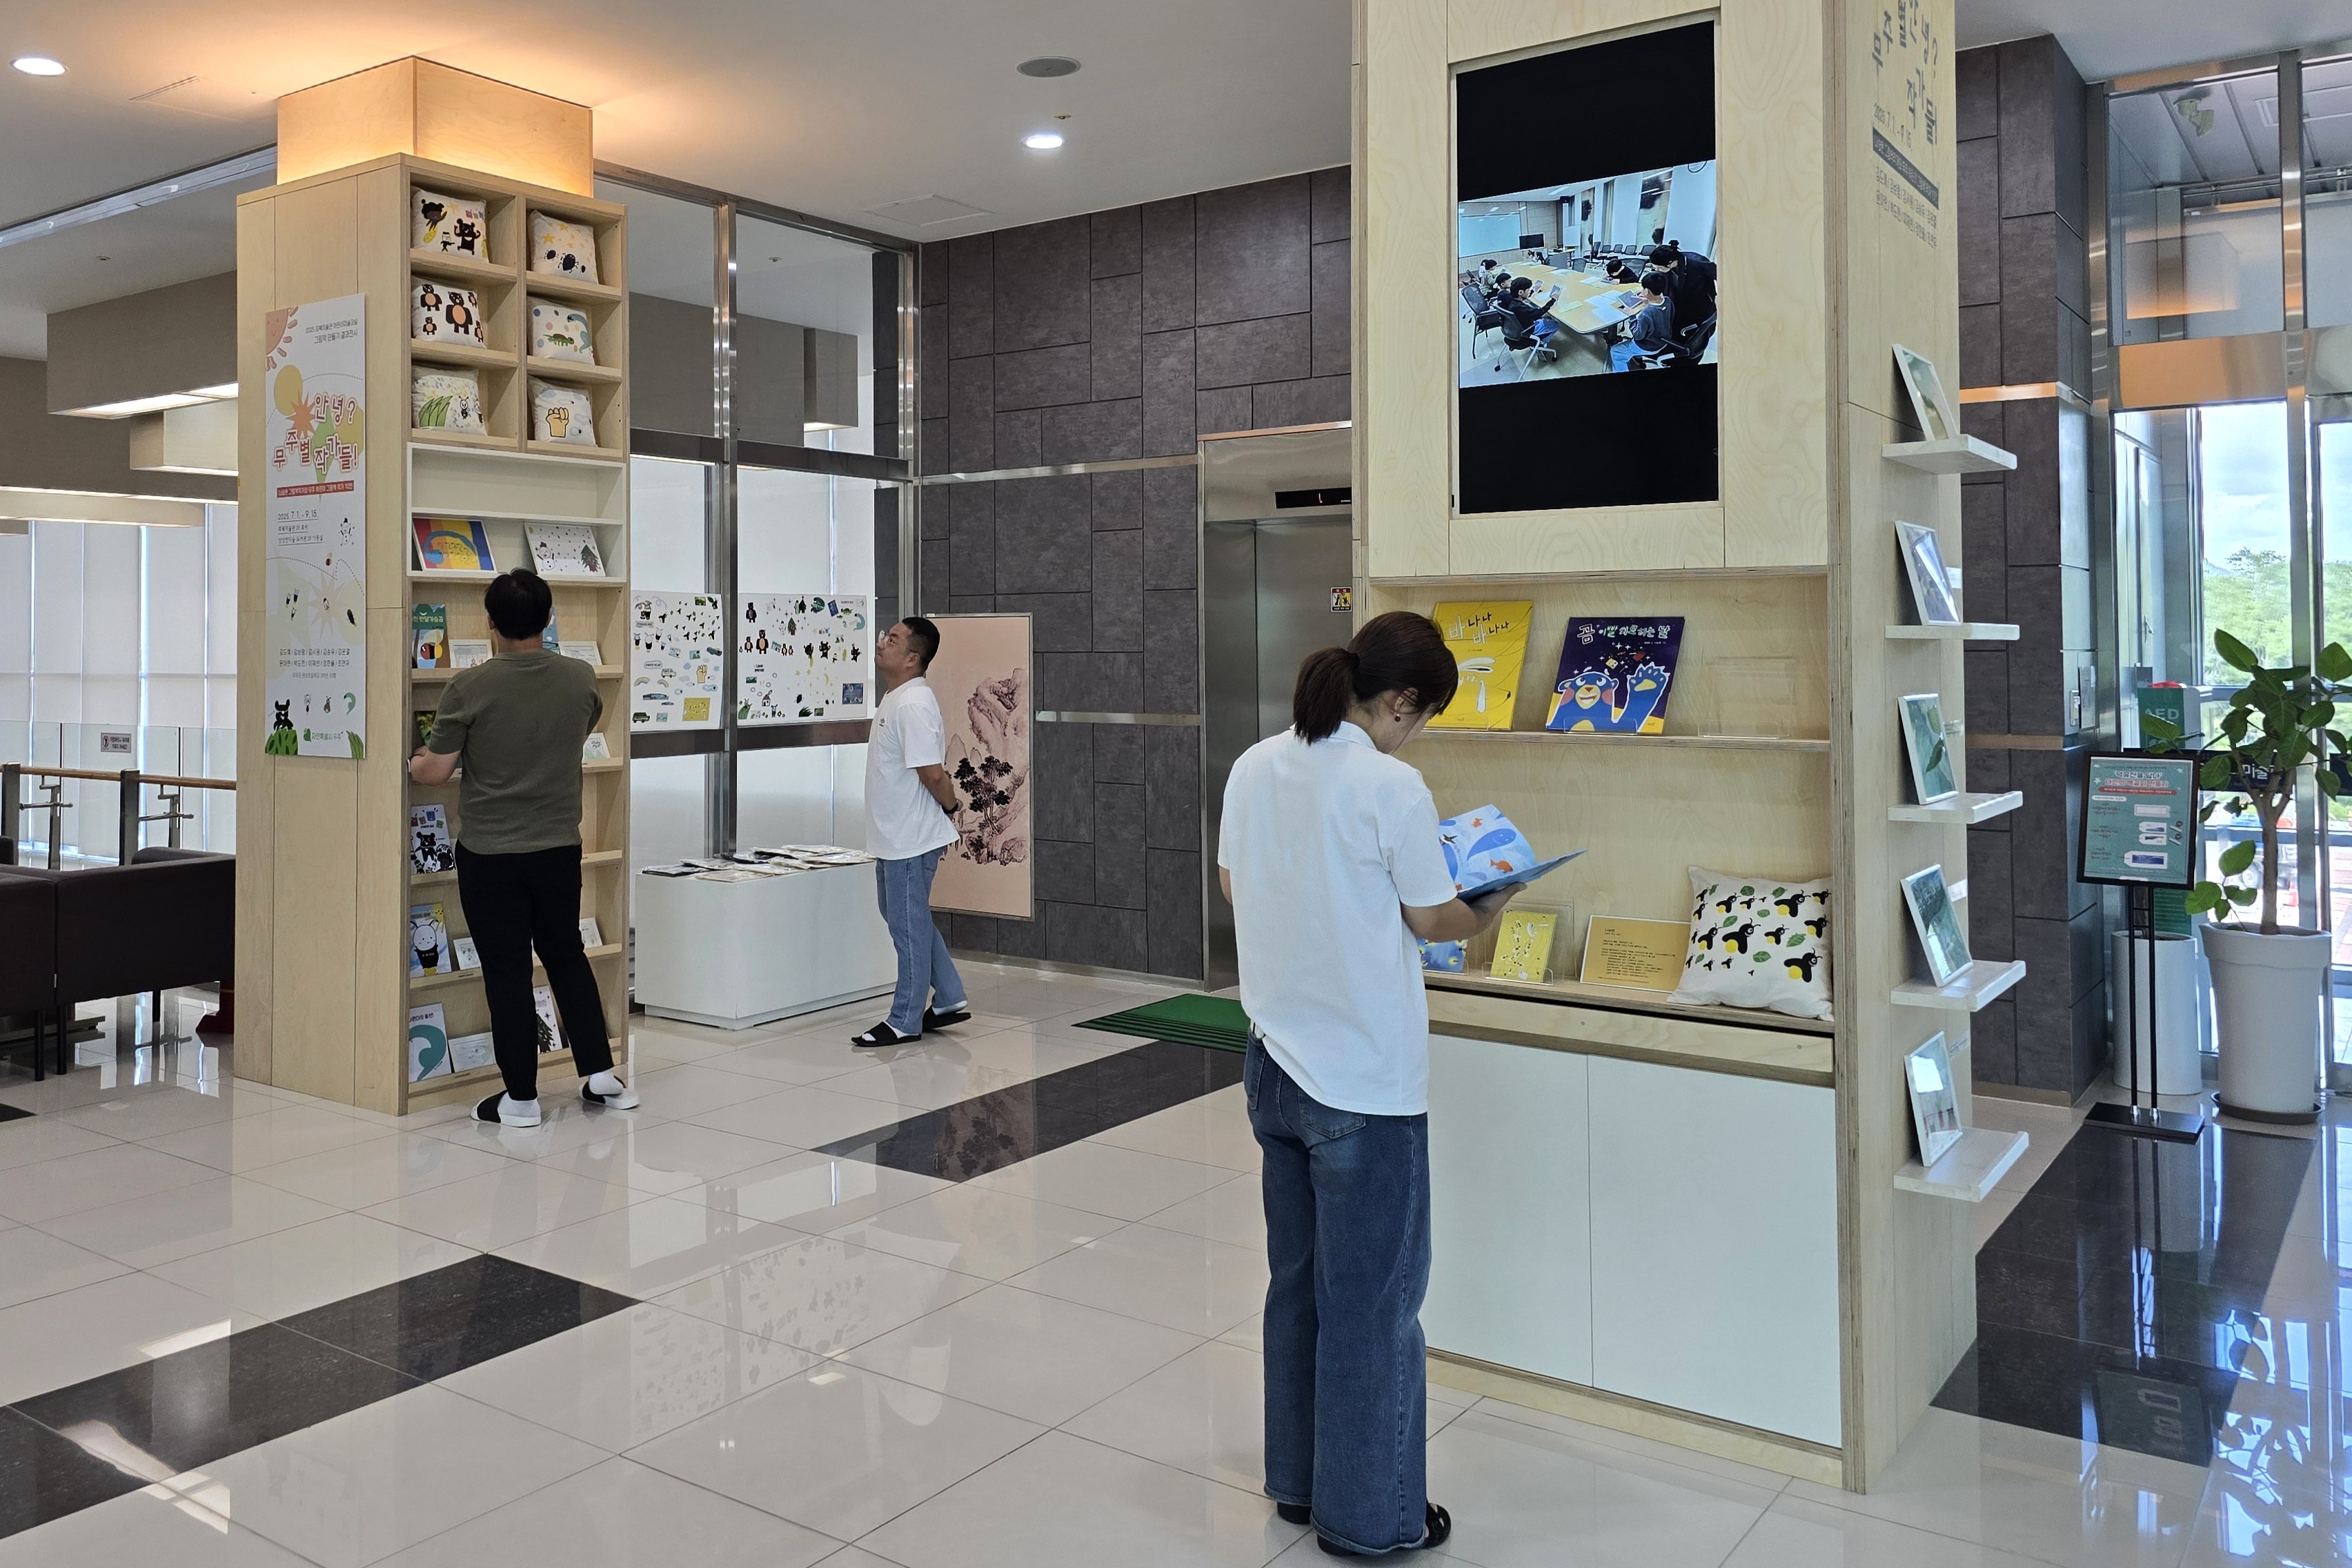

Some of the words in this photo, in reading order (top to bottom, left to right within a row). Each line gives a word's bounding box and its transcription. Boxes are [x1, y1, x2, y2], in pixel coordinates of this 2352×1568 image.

[315, 394, 356, 424] 안녕?
[273, 430, 310, 469] 무주별
[314, 435, 357, 473] 작가들!
[1450, 612, 1492, 639] 바나나
[1473, 621, 1509, 644] 바나나
[1577, 624, 1595, 645] 곰
[1599, 625, 1618, 638] 이빨
[1619, 624, 1655, 638] 치료하는
[1658, 625, 1670, 639] 날
